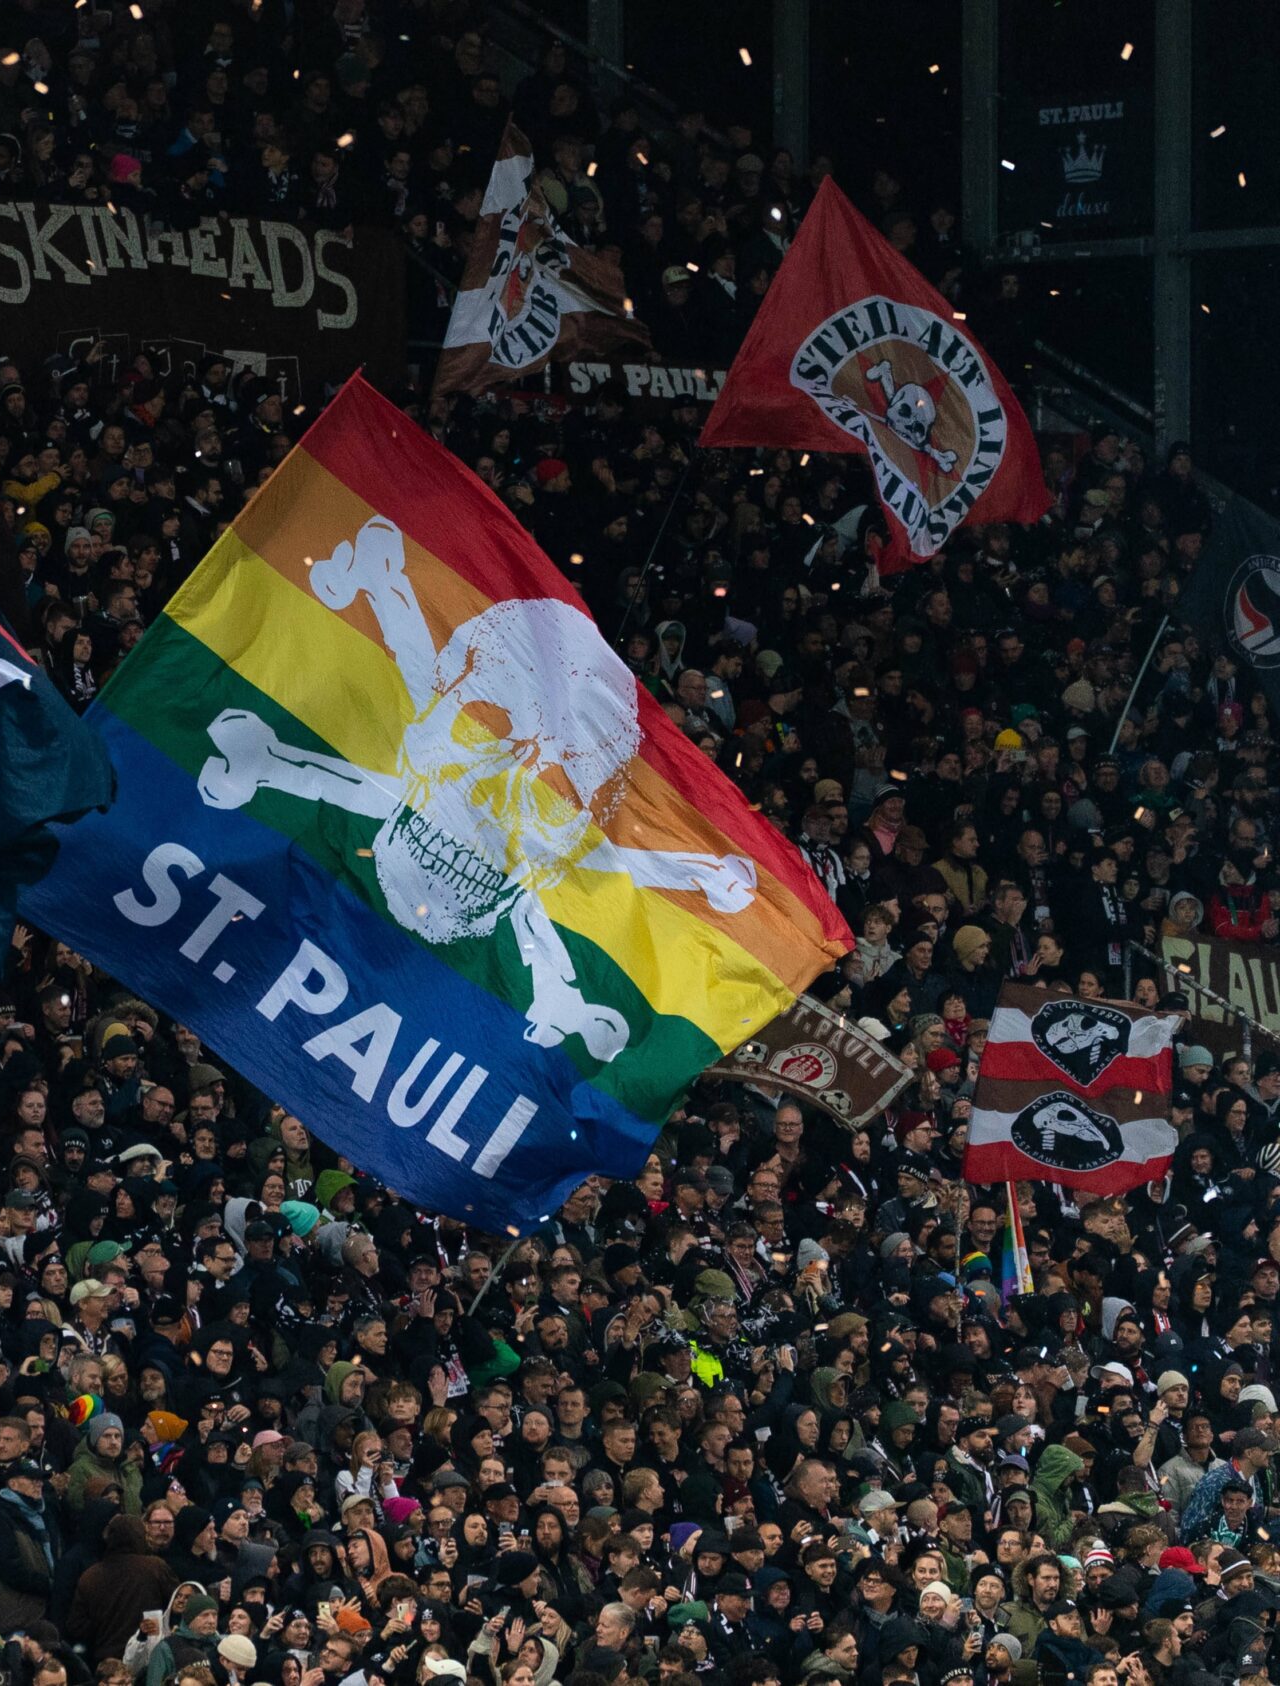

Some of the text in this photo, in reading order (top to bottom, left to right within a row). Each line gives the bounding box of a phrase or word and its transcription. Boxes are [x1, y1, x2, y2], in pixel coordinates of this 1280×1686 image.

[796, 300, 909, 388] STEIL
[927, 404, 1005, 545] LINKS
[112, 842, 540, 1180] ST. PAULI
